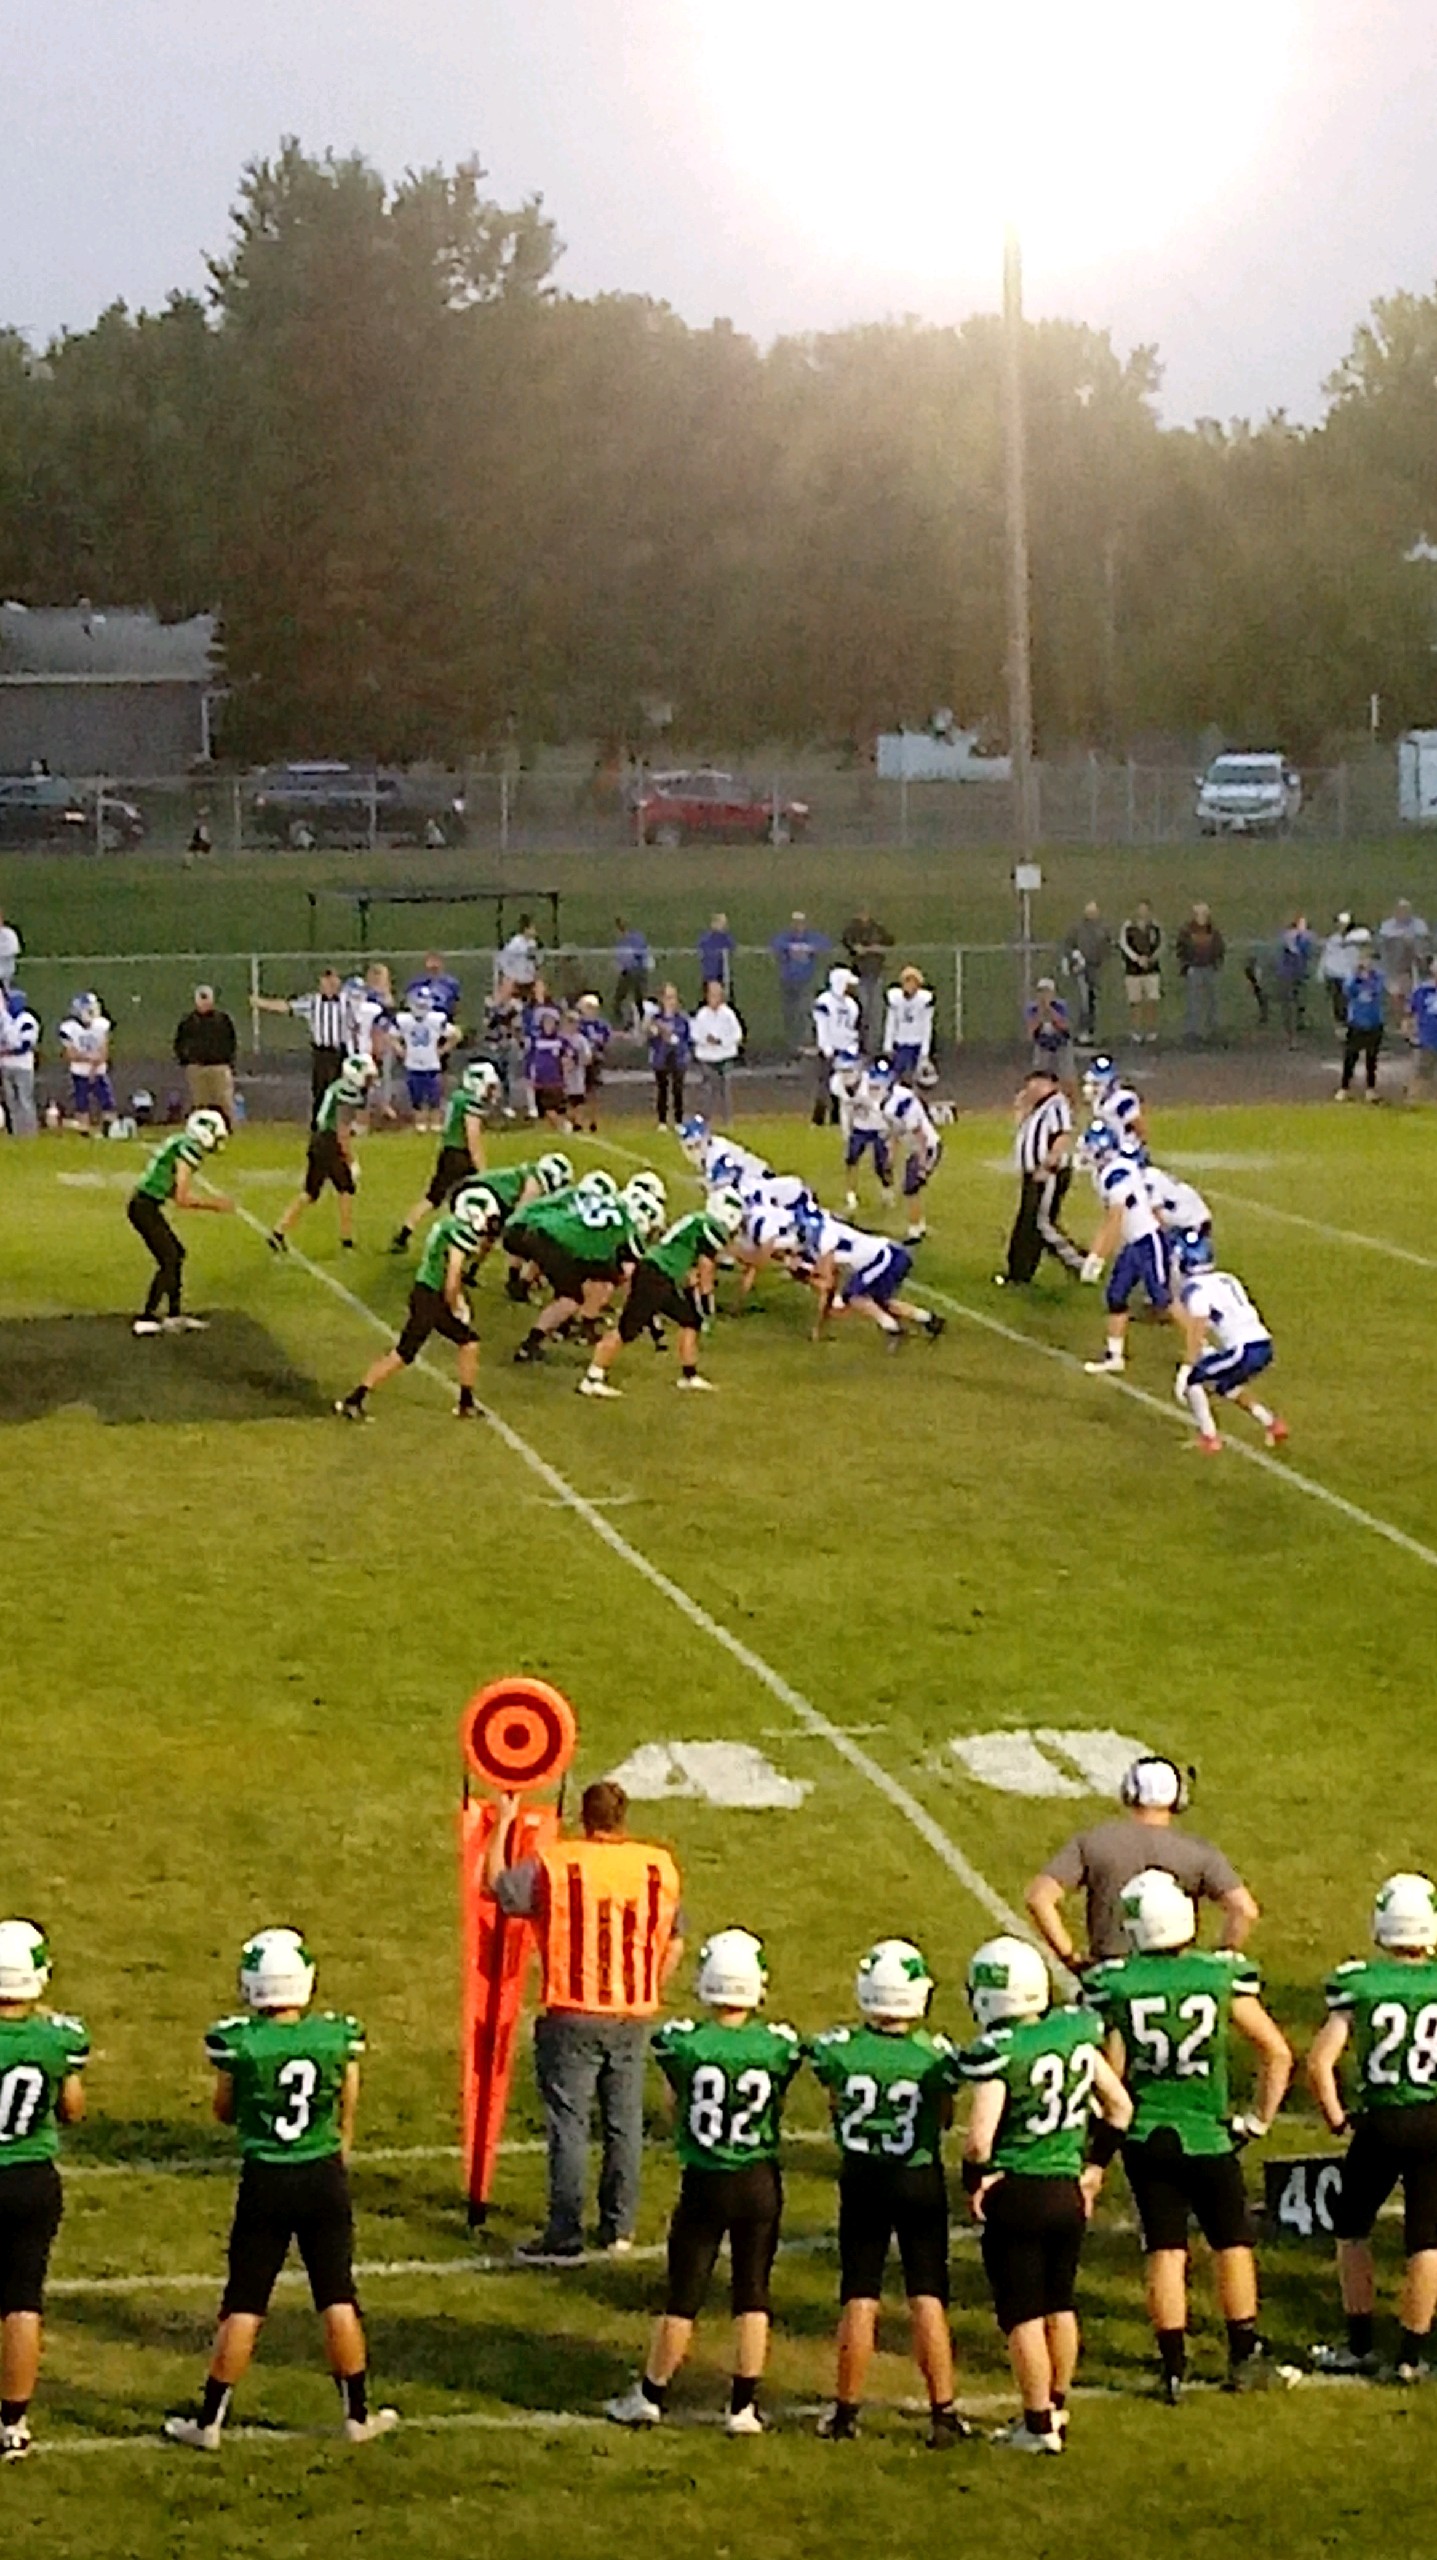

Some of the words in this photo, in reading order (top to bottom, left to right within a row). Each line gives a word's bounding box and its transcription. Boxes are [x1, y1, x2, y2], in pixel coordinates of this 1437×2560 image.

[1130, 1994, 1218, 2077] 52
[1368, 2002, 1437, 2084] 28
[274, 2059, 318, 2141] 3
[689, 2065, 772, 2147] 82
[841, 2074, 921, 2155] 23
[1025, 2042, 1096, 2135] 32
